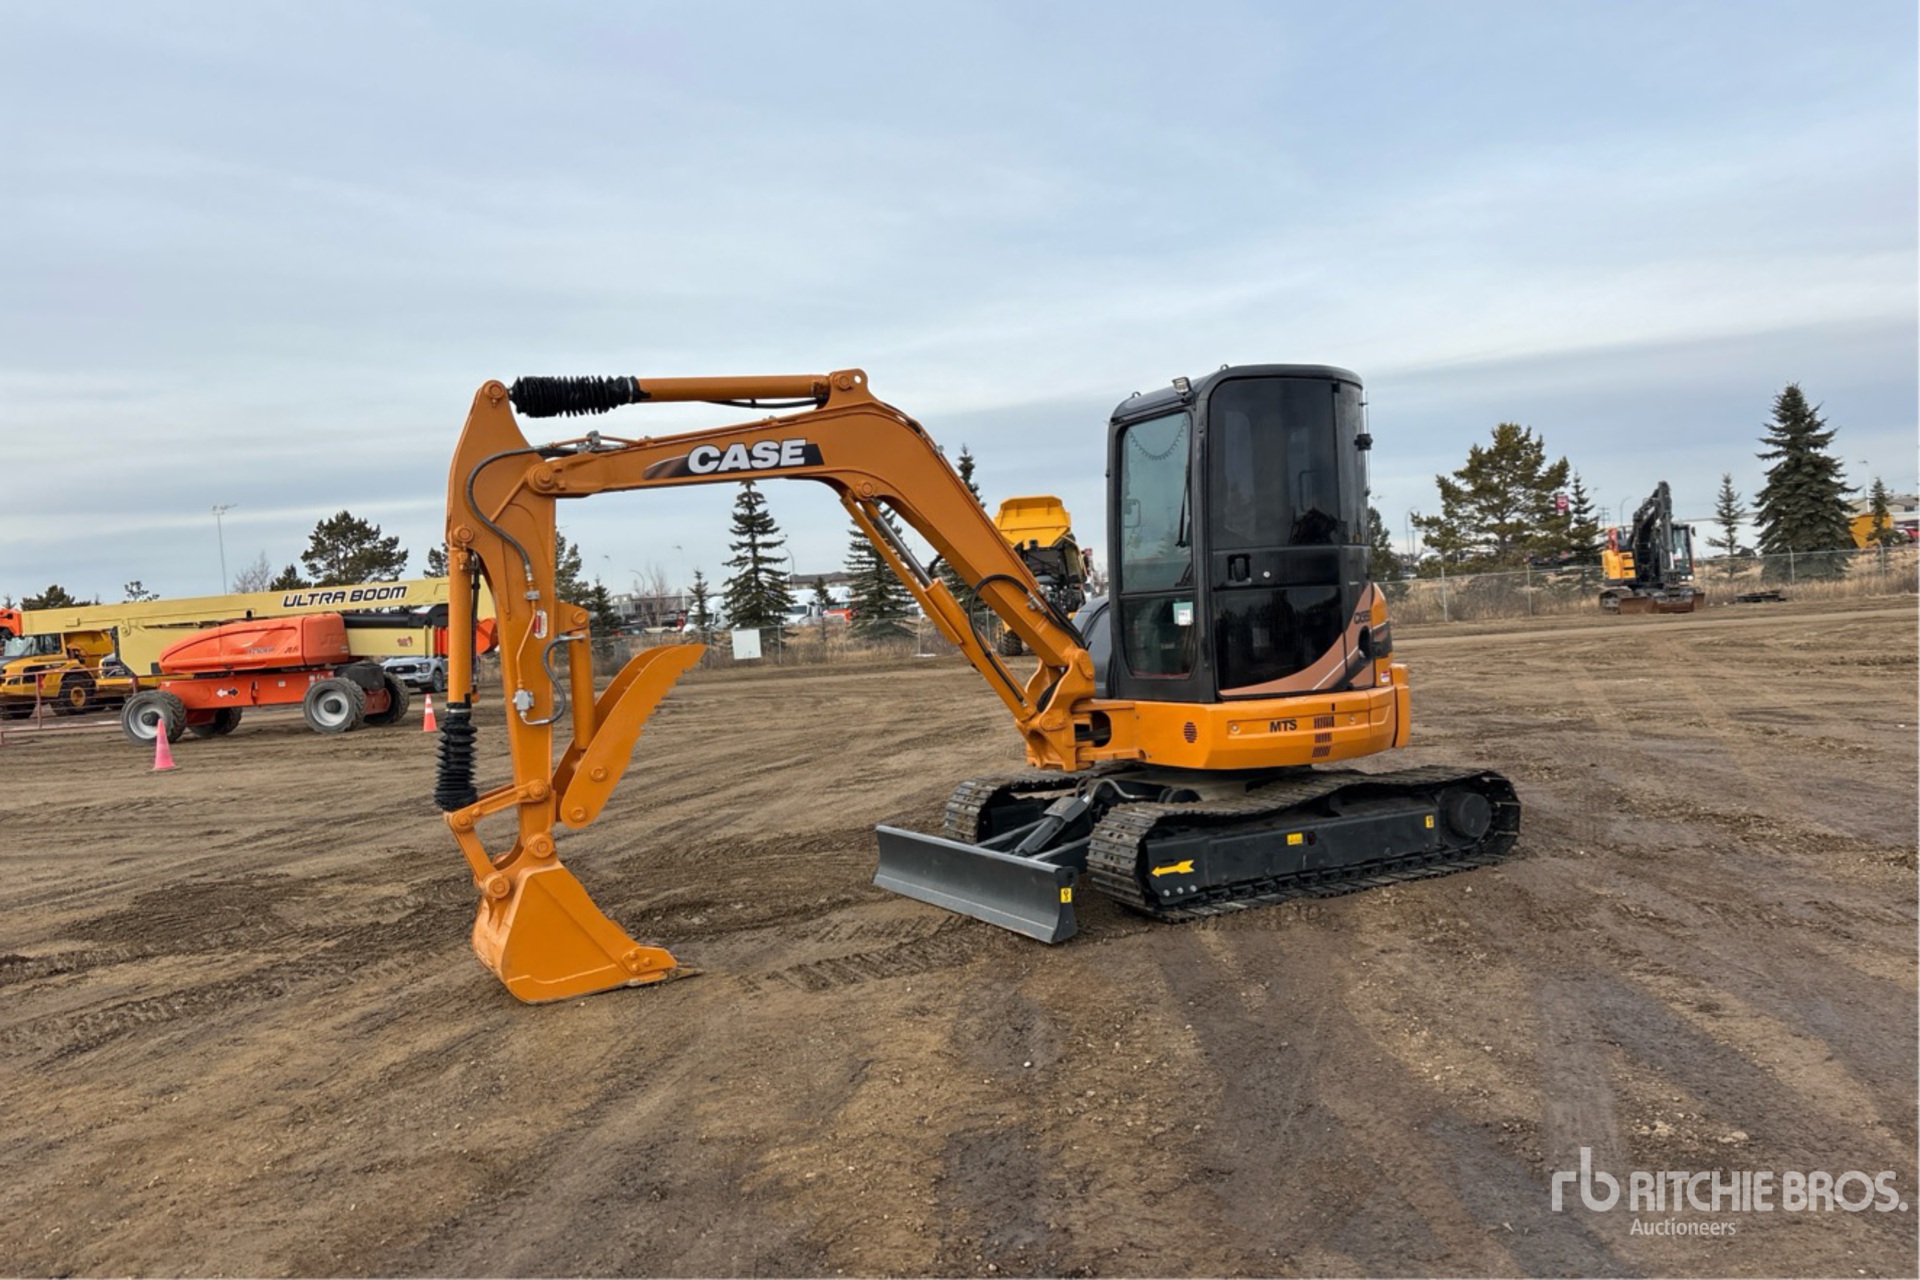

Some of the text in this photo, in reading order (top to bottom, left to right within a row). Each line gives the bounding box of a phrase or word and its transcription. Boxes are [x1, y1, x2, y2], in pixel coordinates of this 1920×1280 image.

[687, 438, 807, 474] CASE
[283, 586, 407, 608] ULTRA BOOM
[1270, 719, 1297, 733] MTS
